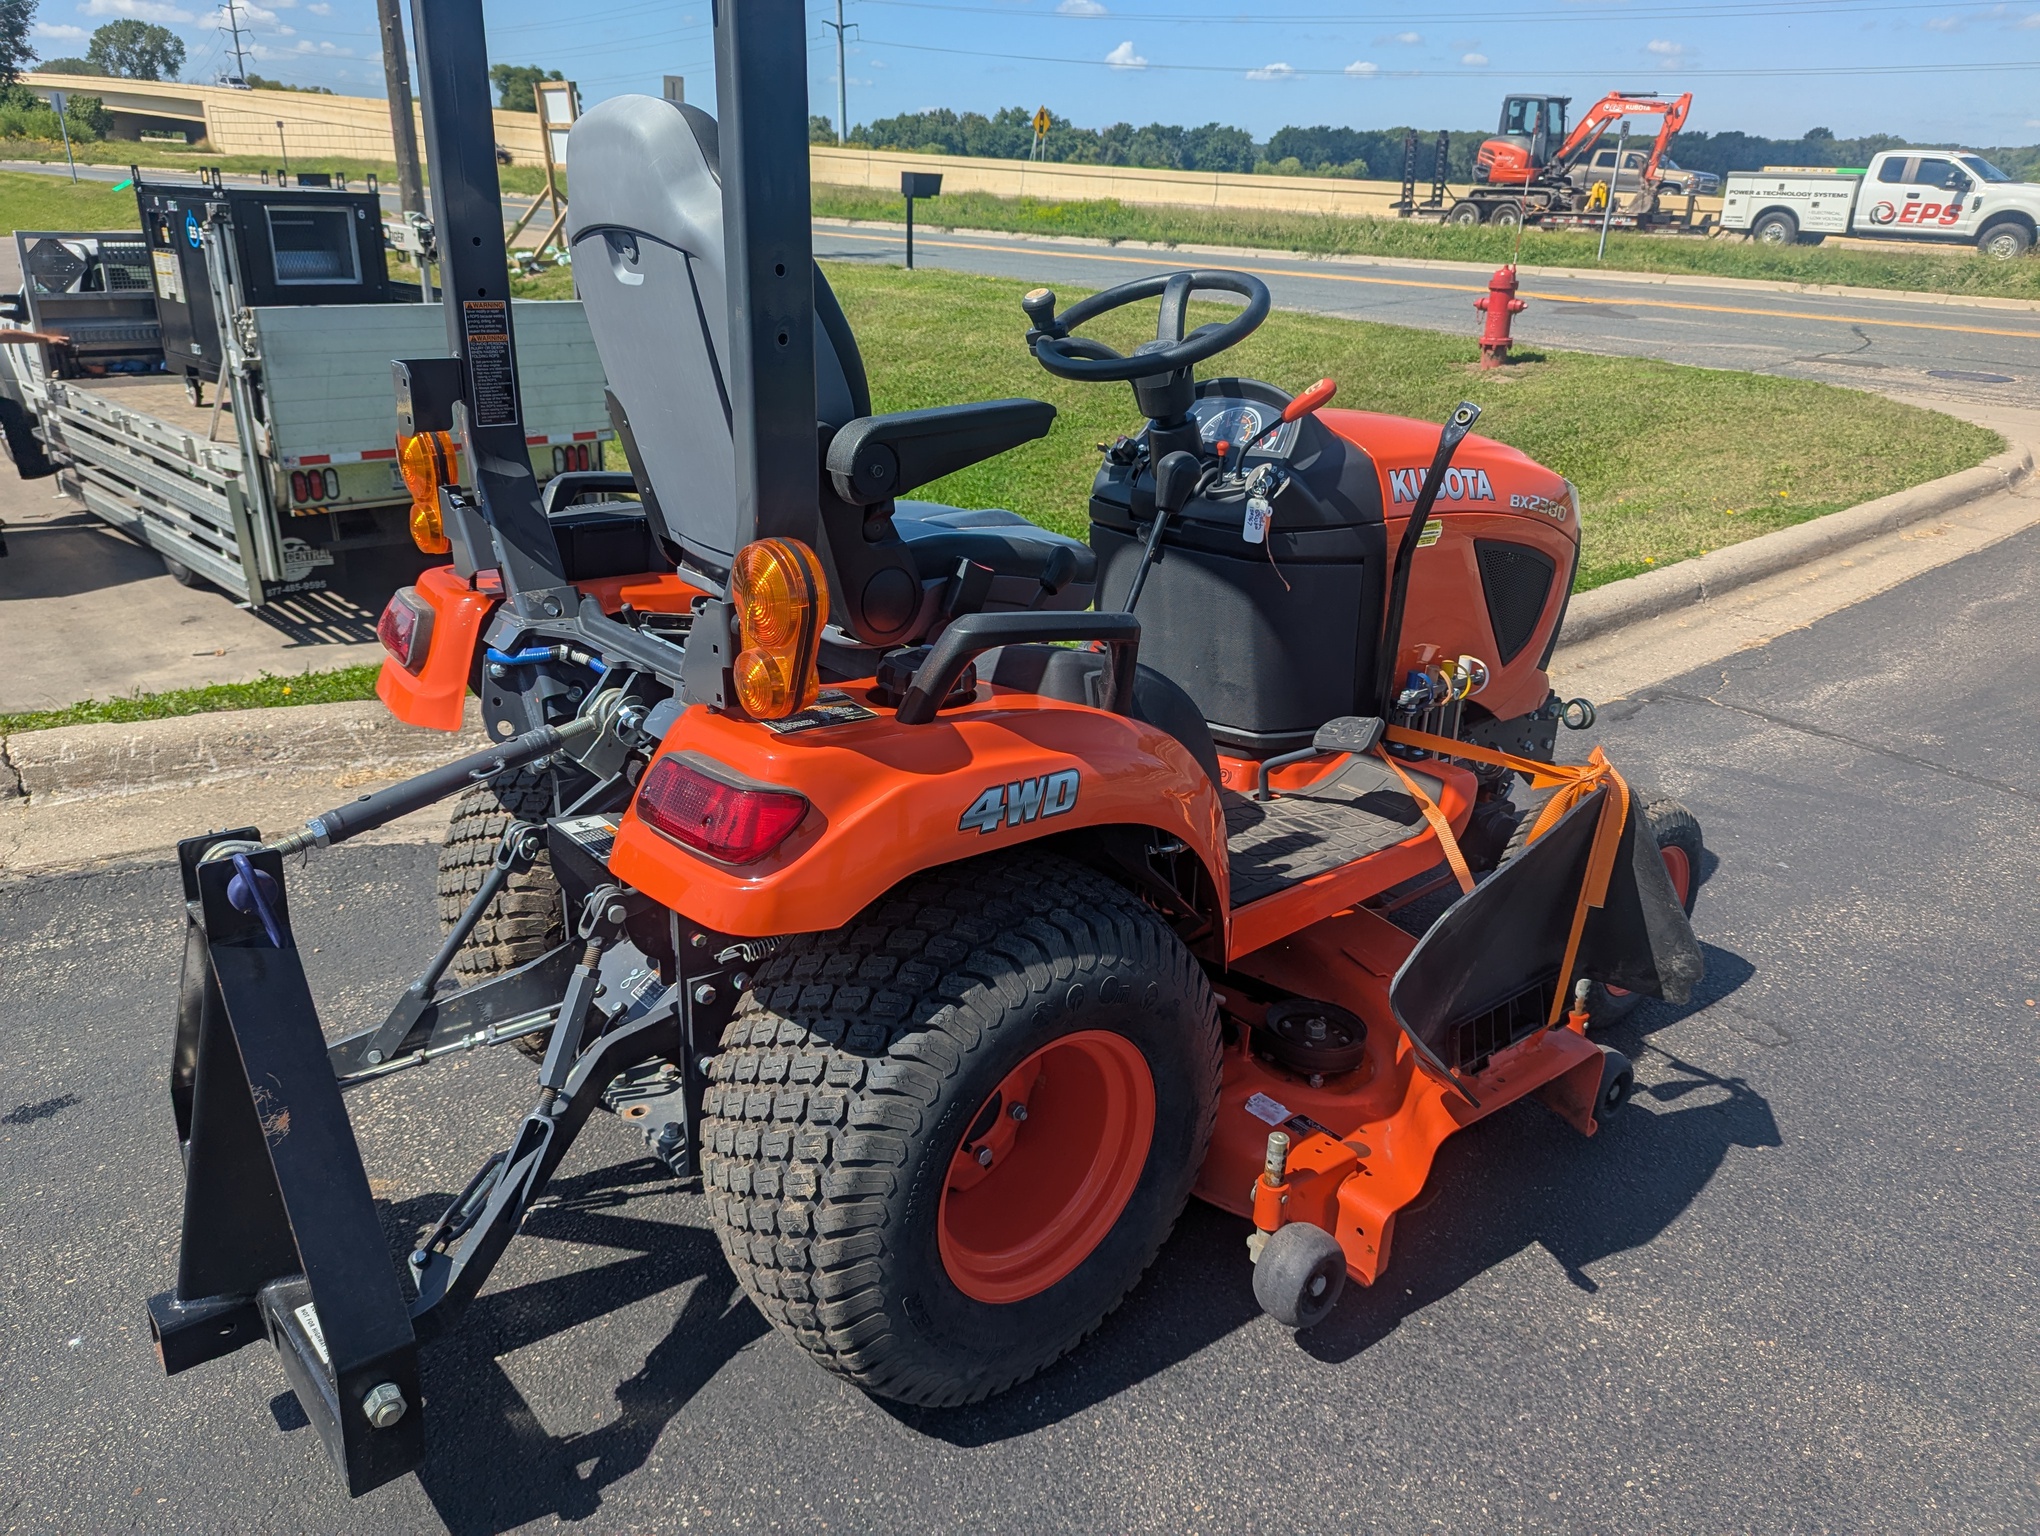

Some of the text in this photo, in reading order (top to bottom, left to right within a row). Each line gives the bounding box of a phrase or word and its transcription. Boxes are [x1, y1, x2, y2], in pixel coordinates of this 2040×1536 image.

[358, 208, 366, 220] 6
[1898, 202, 1963, 226] EPS
[1388, 468, 1496, 503] KUOTA
[1509, 494, 1568, 523] BX2380
[286, 548, 333, 562] CENTRAL
[958, 768, 1080, 834] 4WD
[301, 1308, 310, 1318] NOT
[306, 1318, 315, 1328] FOR
